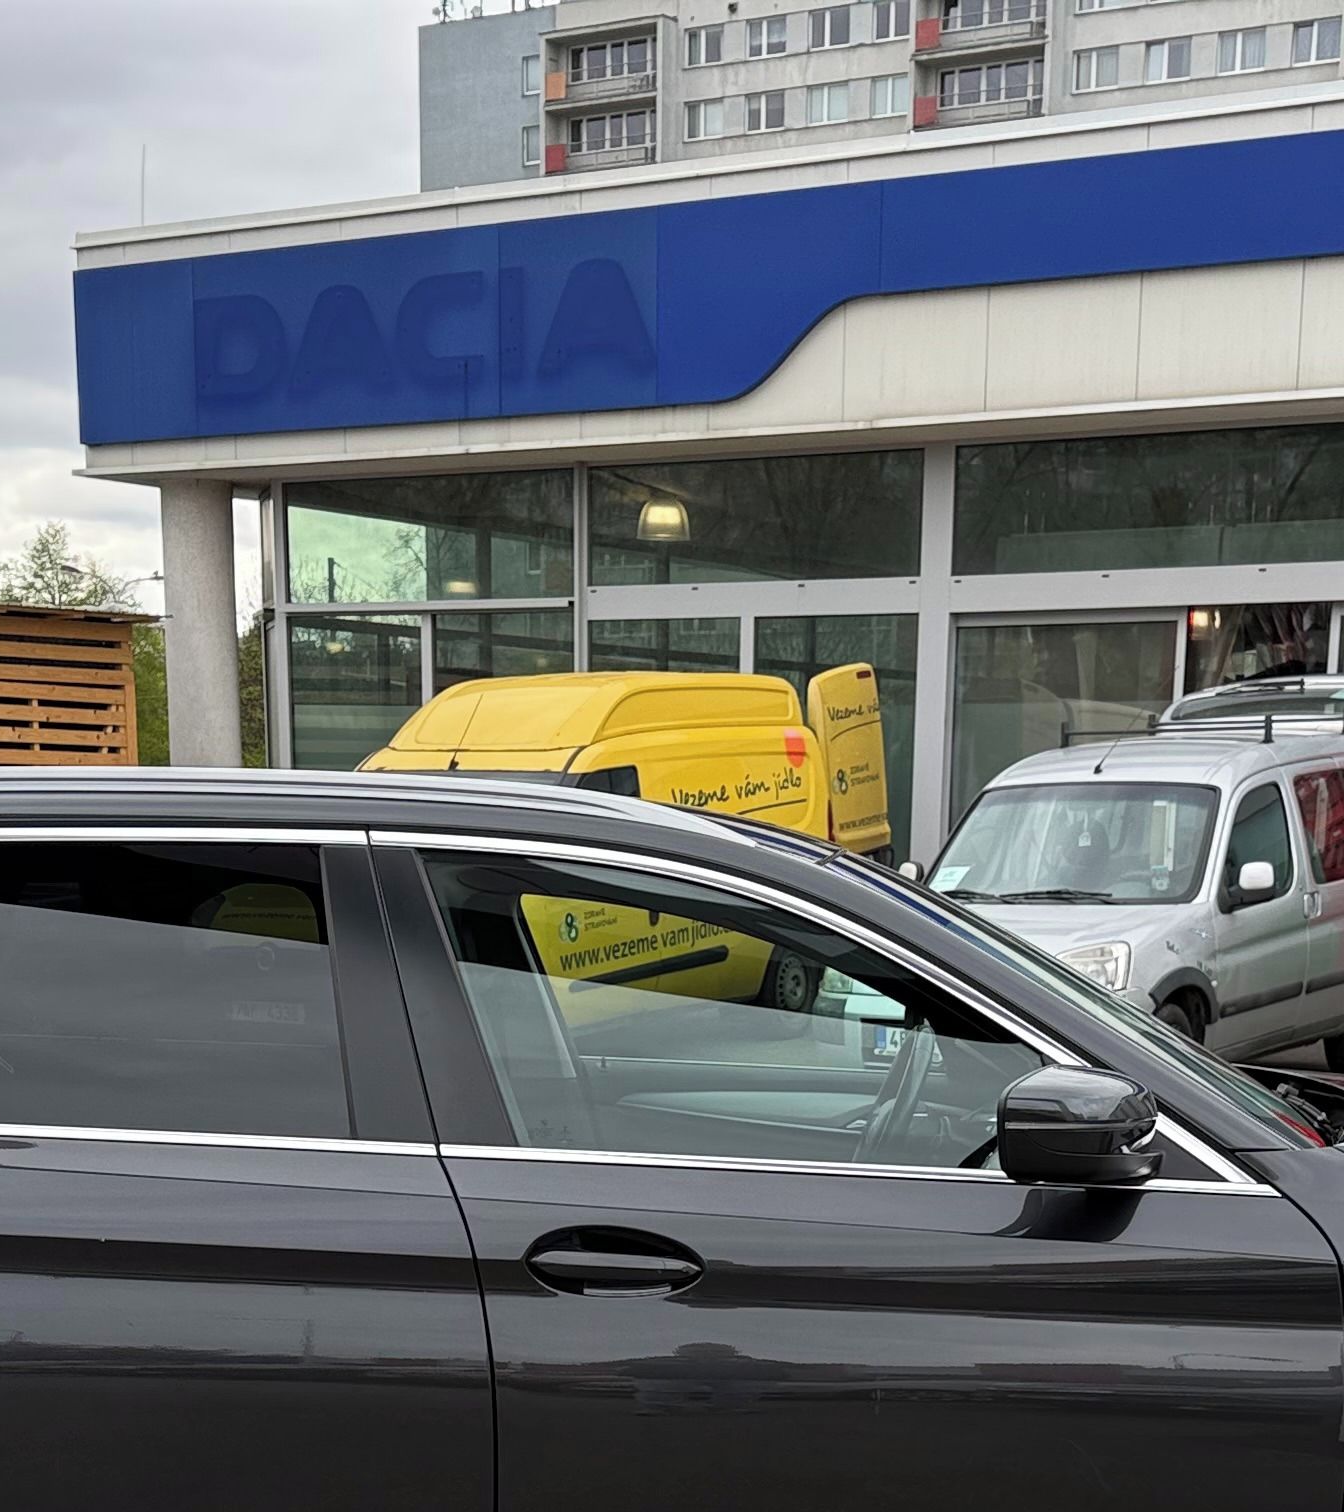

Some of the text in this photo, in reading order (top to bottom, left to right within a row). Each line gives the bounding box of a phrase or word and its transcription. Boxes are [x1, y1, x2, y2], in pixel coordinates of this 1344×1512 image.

[193, 258, 655, 402] DACIA
[735, 774, 771, 800] vám
[772, 767, 802, 801] jídlo
